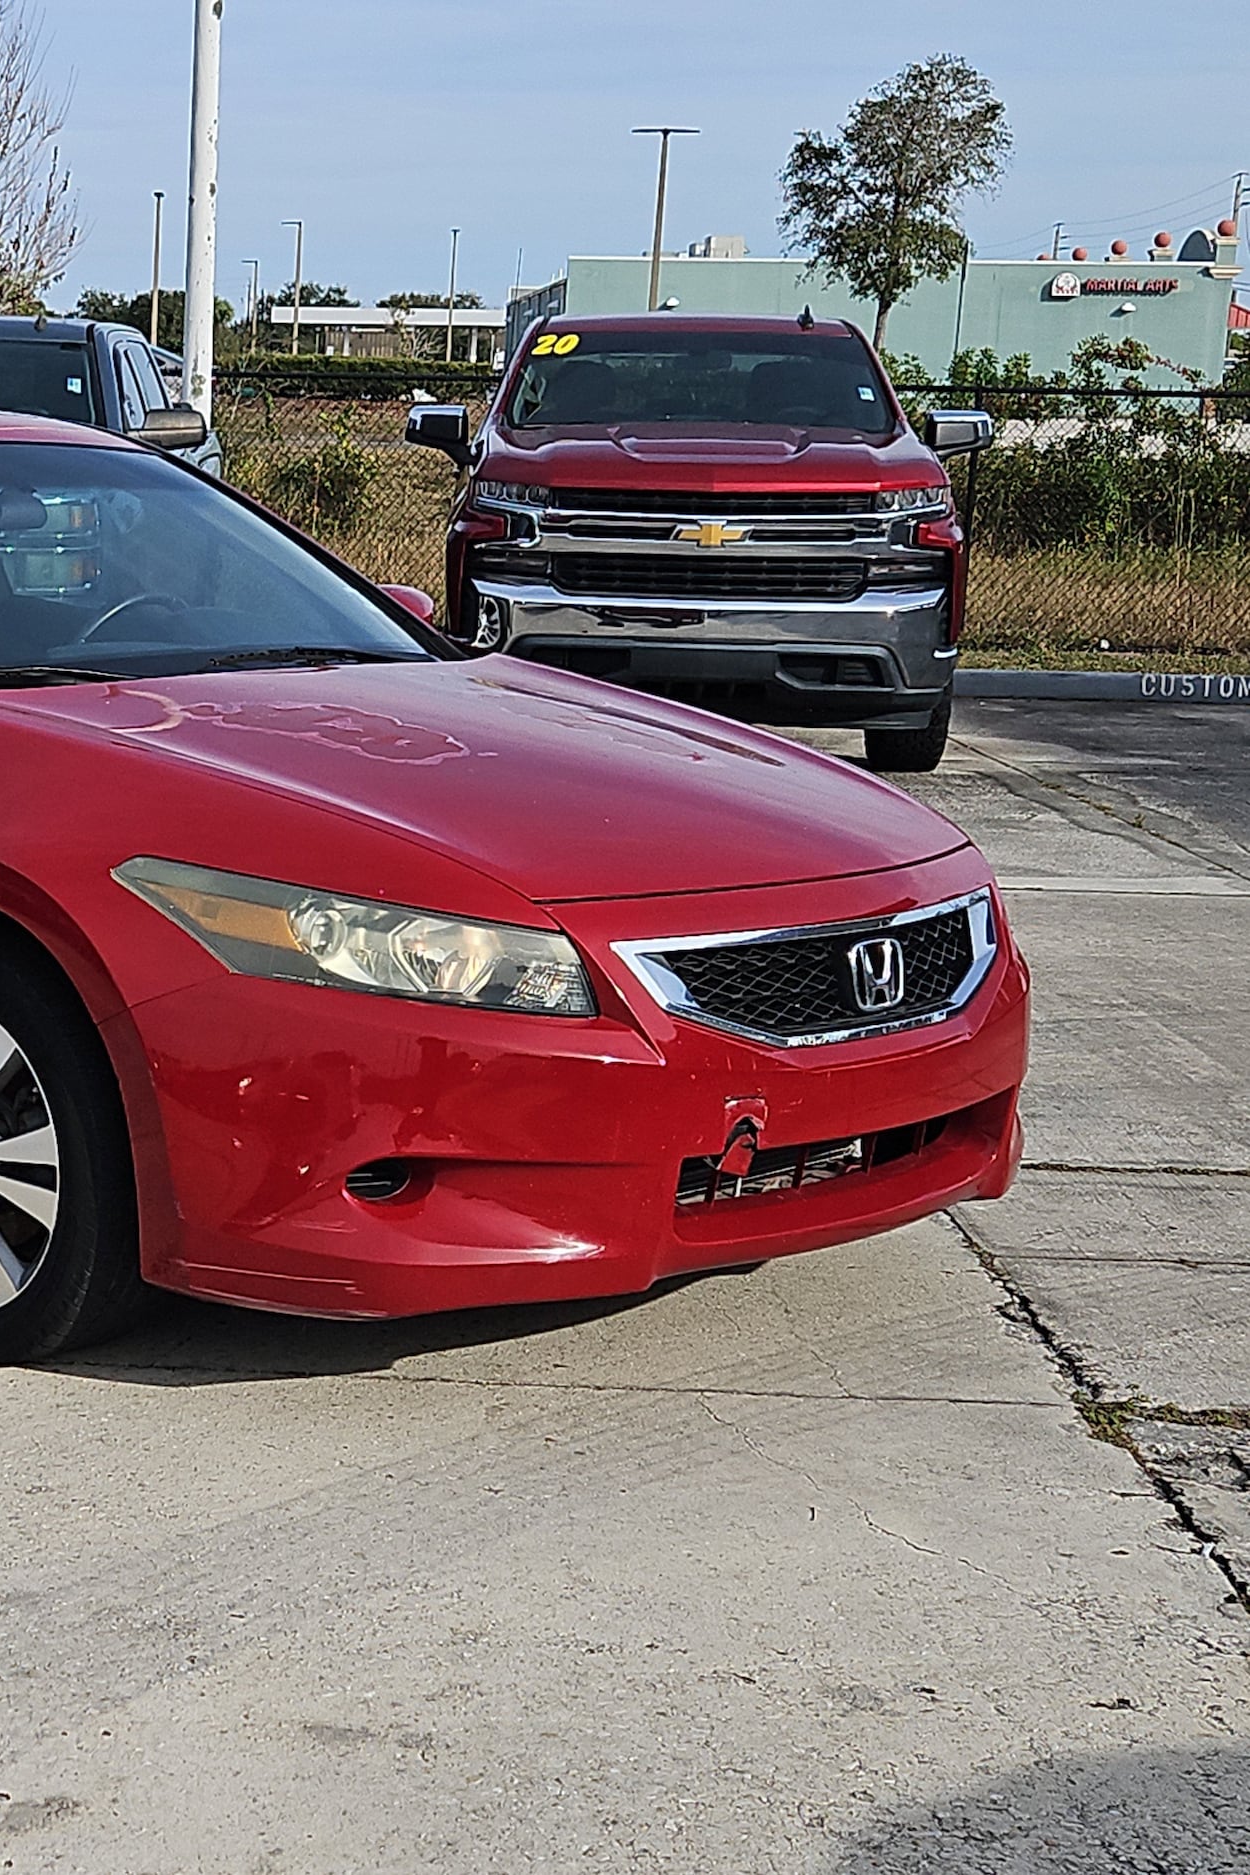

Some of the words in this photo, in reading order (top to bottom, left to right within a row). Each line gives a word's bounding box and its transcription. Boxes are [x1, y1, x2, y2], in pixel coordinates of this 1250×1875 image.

[1086, 278, 1143, 291] MARTIAL
[1145, 279, 1179, 291] ARTS
[531, 334, 580, 355] 20
